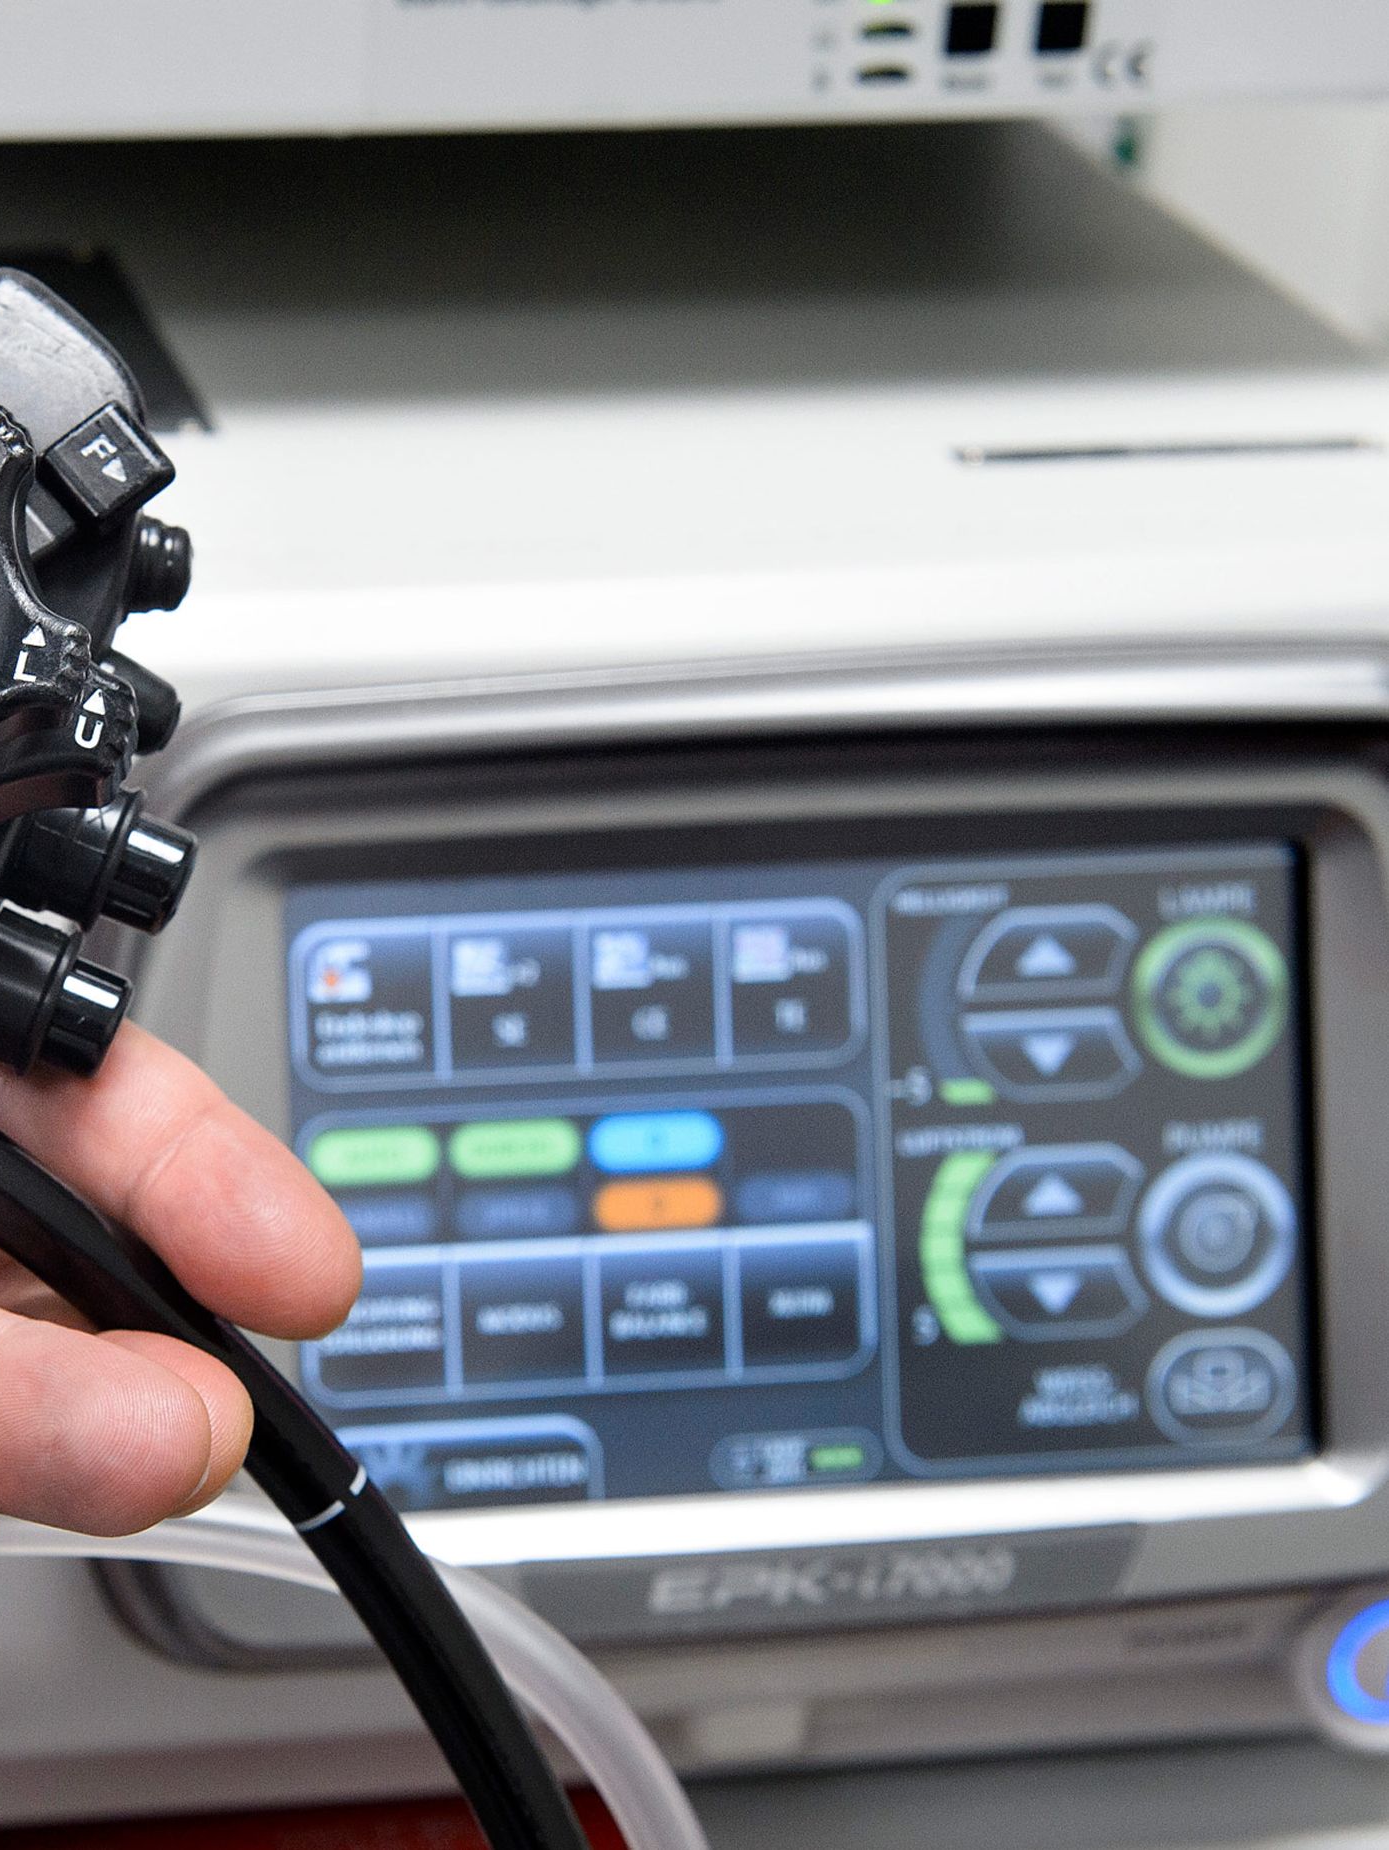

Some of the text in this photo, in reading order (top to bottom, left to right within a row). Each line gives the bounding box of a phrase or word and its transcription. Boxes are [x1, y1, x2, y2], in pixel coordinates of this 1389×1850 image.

[80, 435, 119, 460] F
[13, 650, 38, 683] L
[74, 715, 104, 750] U
